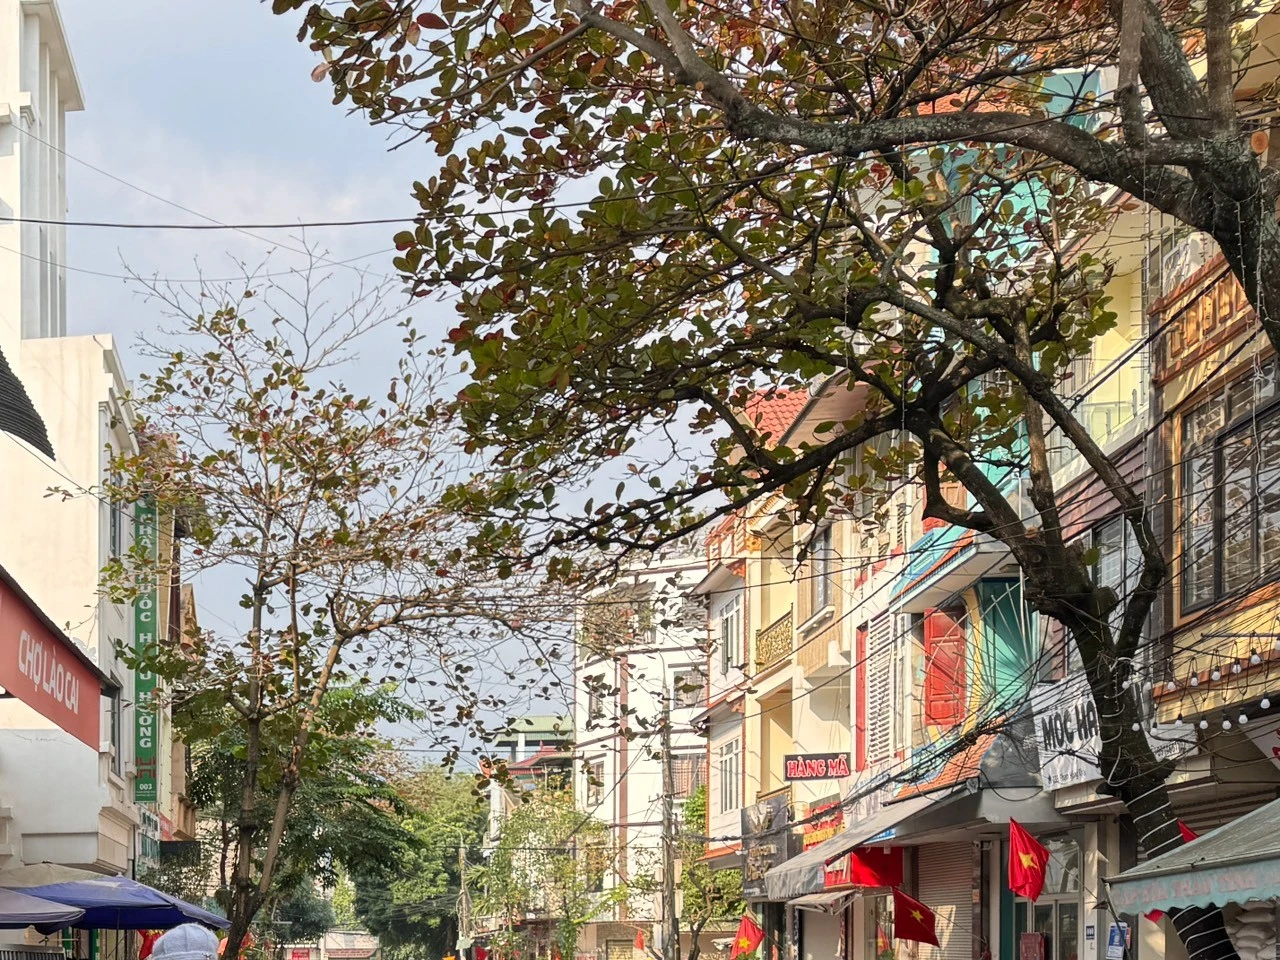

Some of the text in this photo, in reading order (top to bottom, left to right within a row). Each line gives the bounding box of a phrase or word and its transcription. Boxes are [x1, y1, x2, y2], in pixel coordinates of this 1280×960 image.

[18, 629, 79, 715] CHỢ LÀO CAI
[786, 754, 850, 778] HÀNG MÃ
